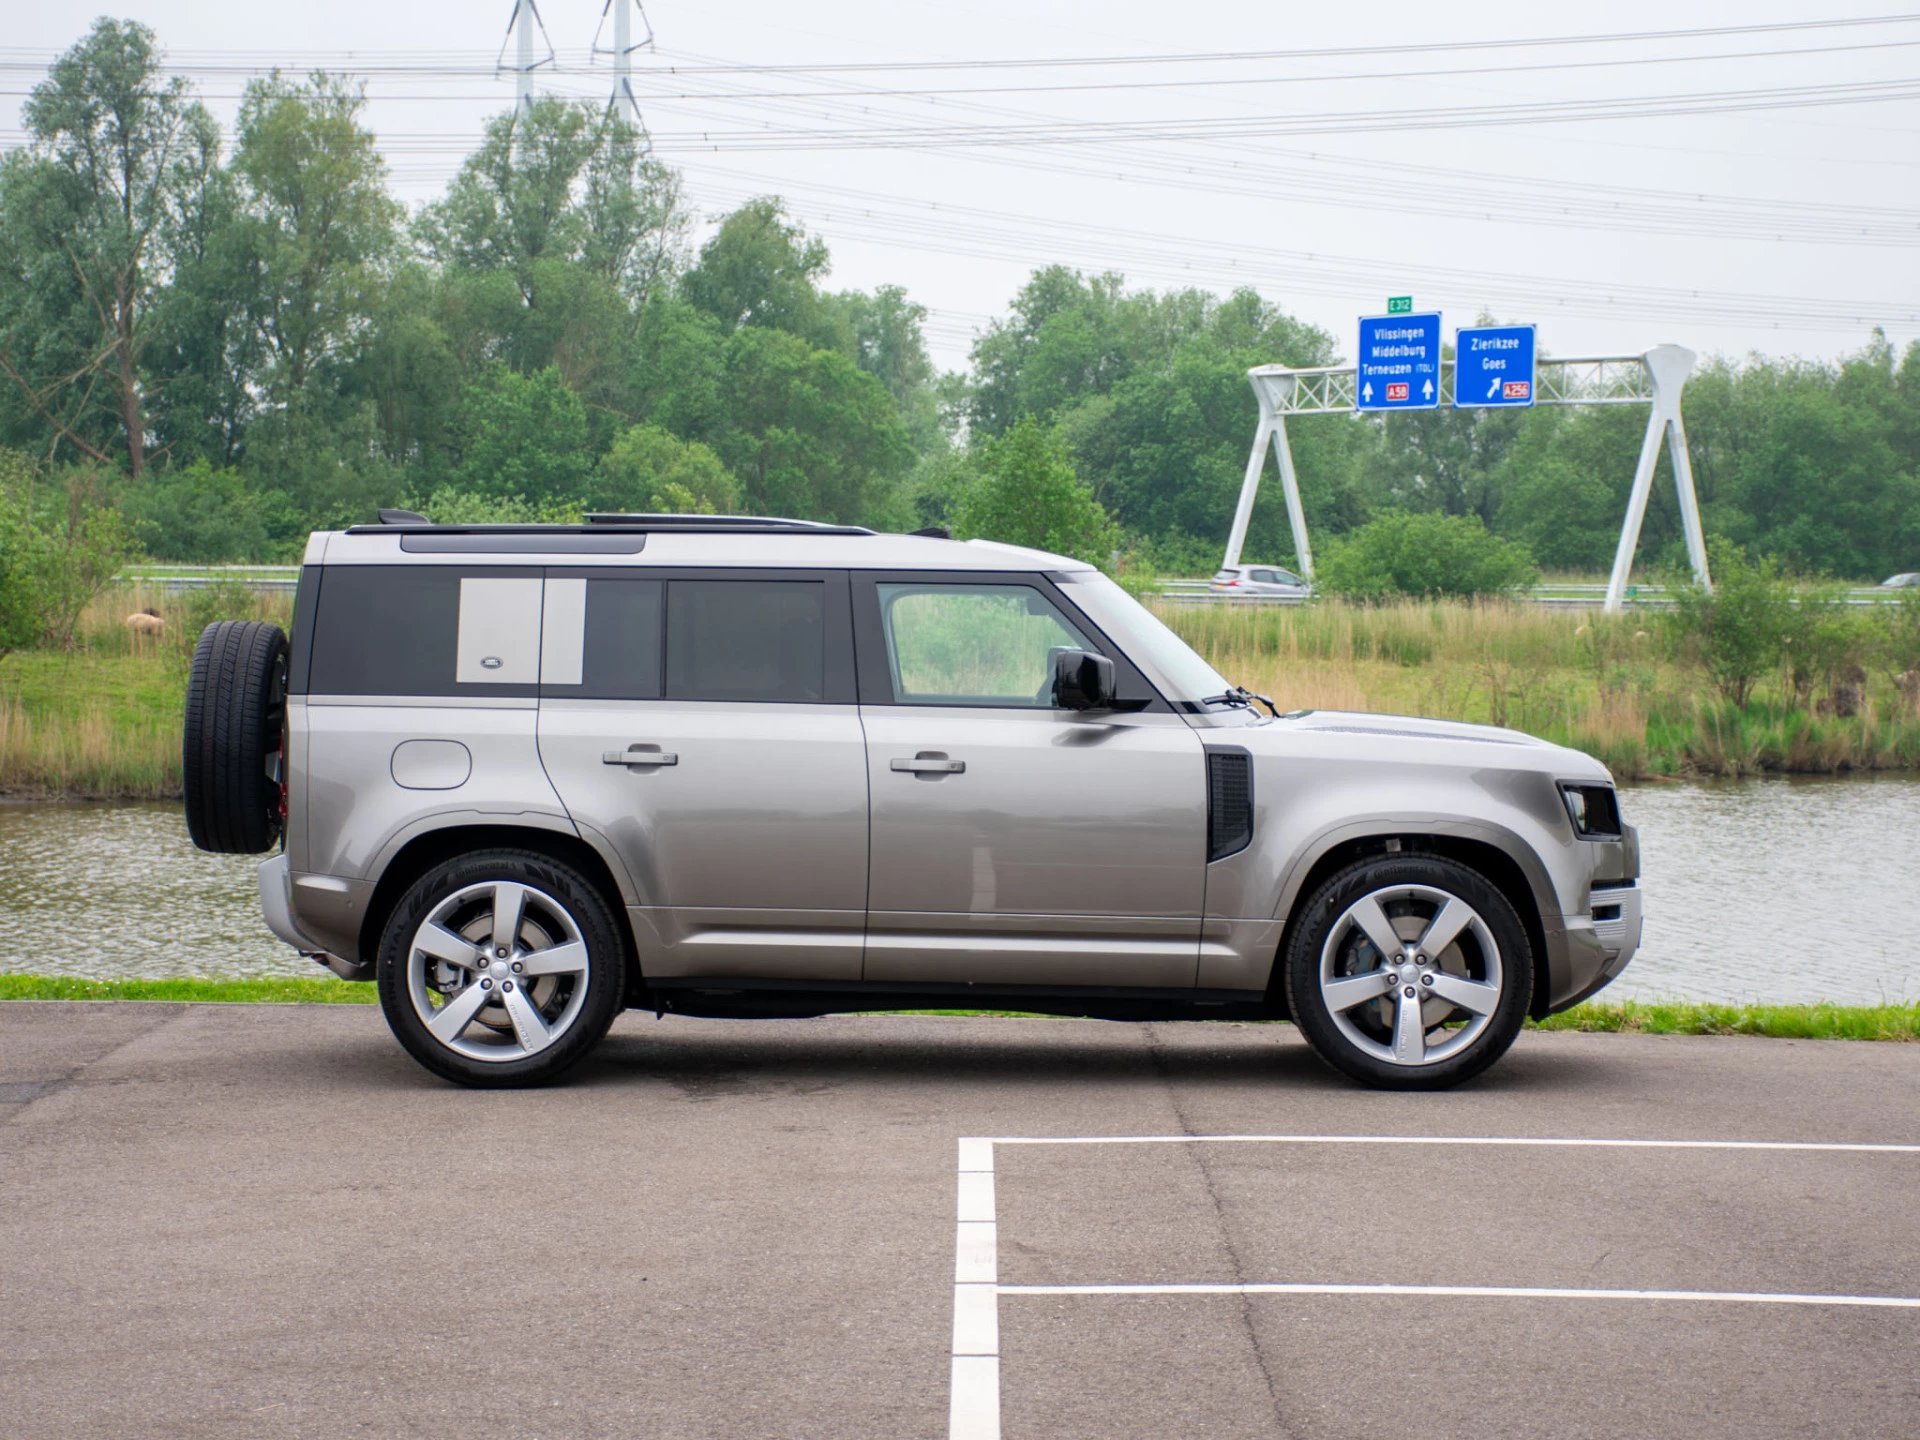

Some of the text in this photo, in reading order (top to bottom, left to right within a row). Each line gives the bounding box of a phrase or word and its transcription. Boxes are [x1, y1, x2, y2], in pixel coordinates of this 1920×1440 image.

[1390, 299, 1410, 311] E 312
[1374, 328, 1424, 343] Vlissingen
[1471, 338, 1520, 351] Zierikzee
[1372, 345, 1426, 359] Middelburg
[1362, 363, 1412, 375] Terneuzen
[1482, 357, 1506, 370] Goes
